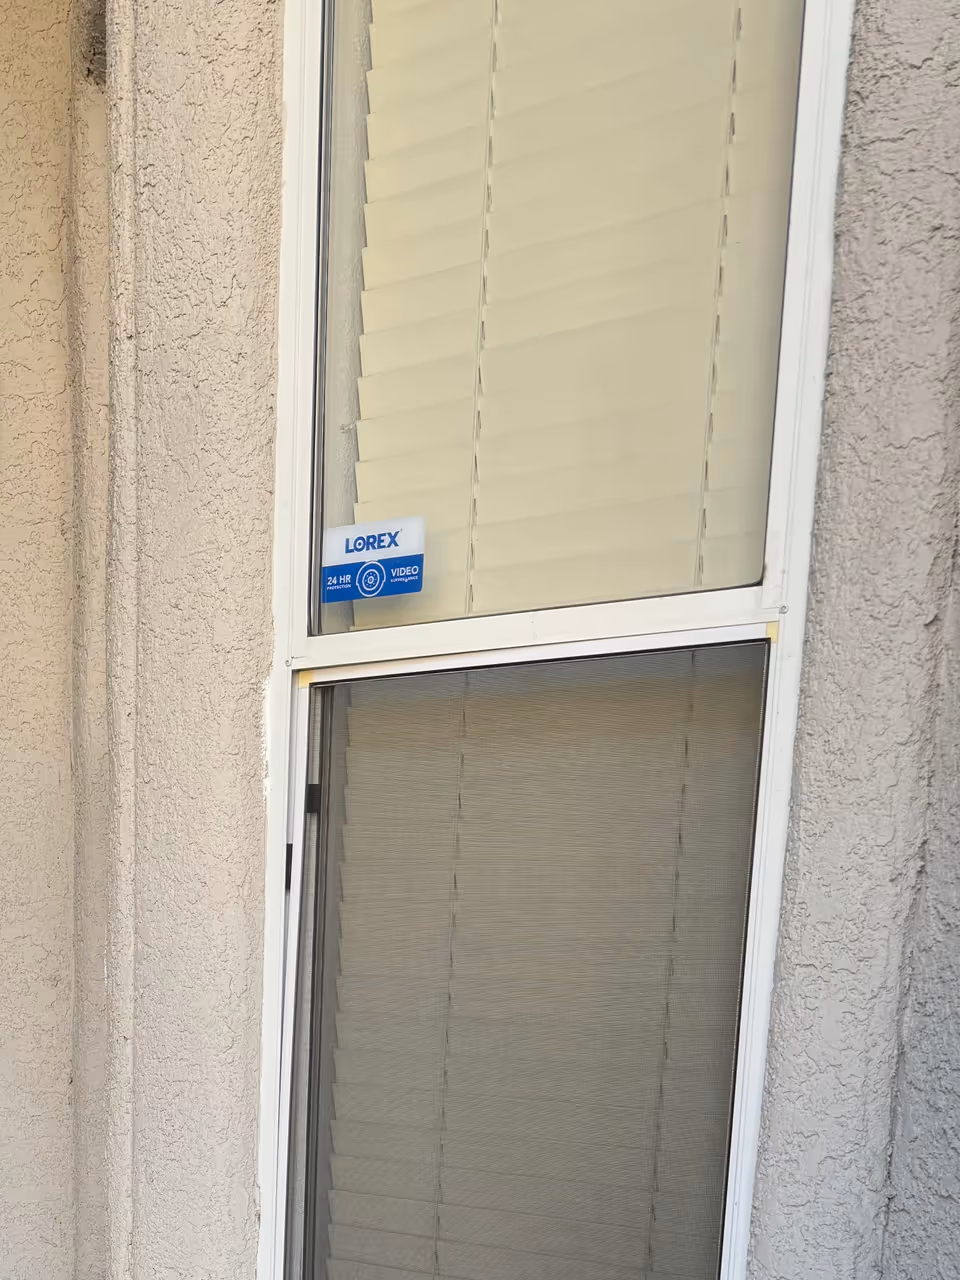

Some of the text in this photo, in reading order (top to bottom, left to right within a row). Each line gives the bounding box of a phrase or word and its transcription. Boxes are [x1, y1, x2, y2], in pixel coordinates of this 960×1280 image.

[345, 531, 400, 554] LOREX
[390, 565, 419, 577] VIDEO
[327, 574, 351, 585] 24 HR
